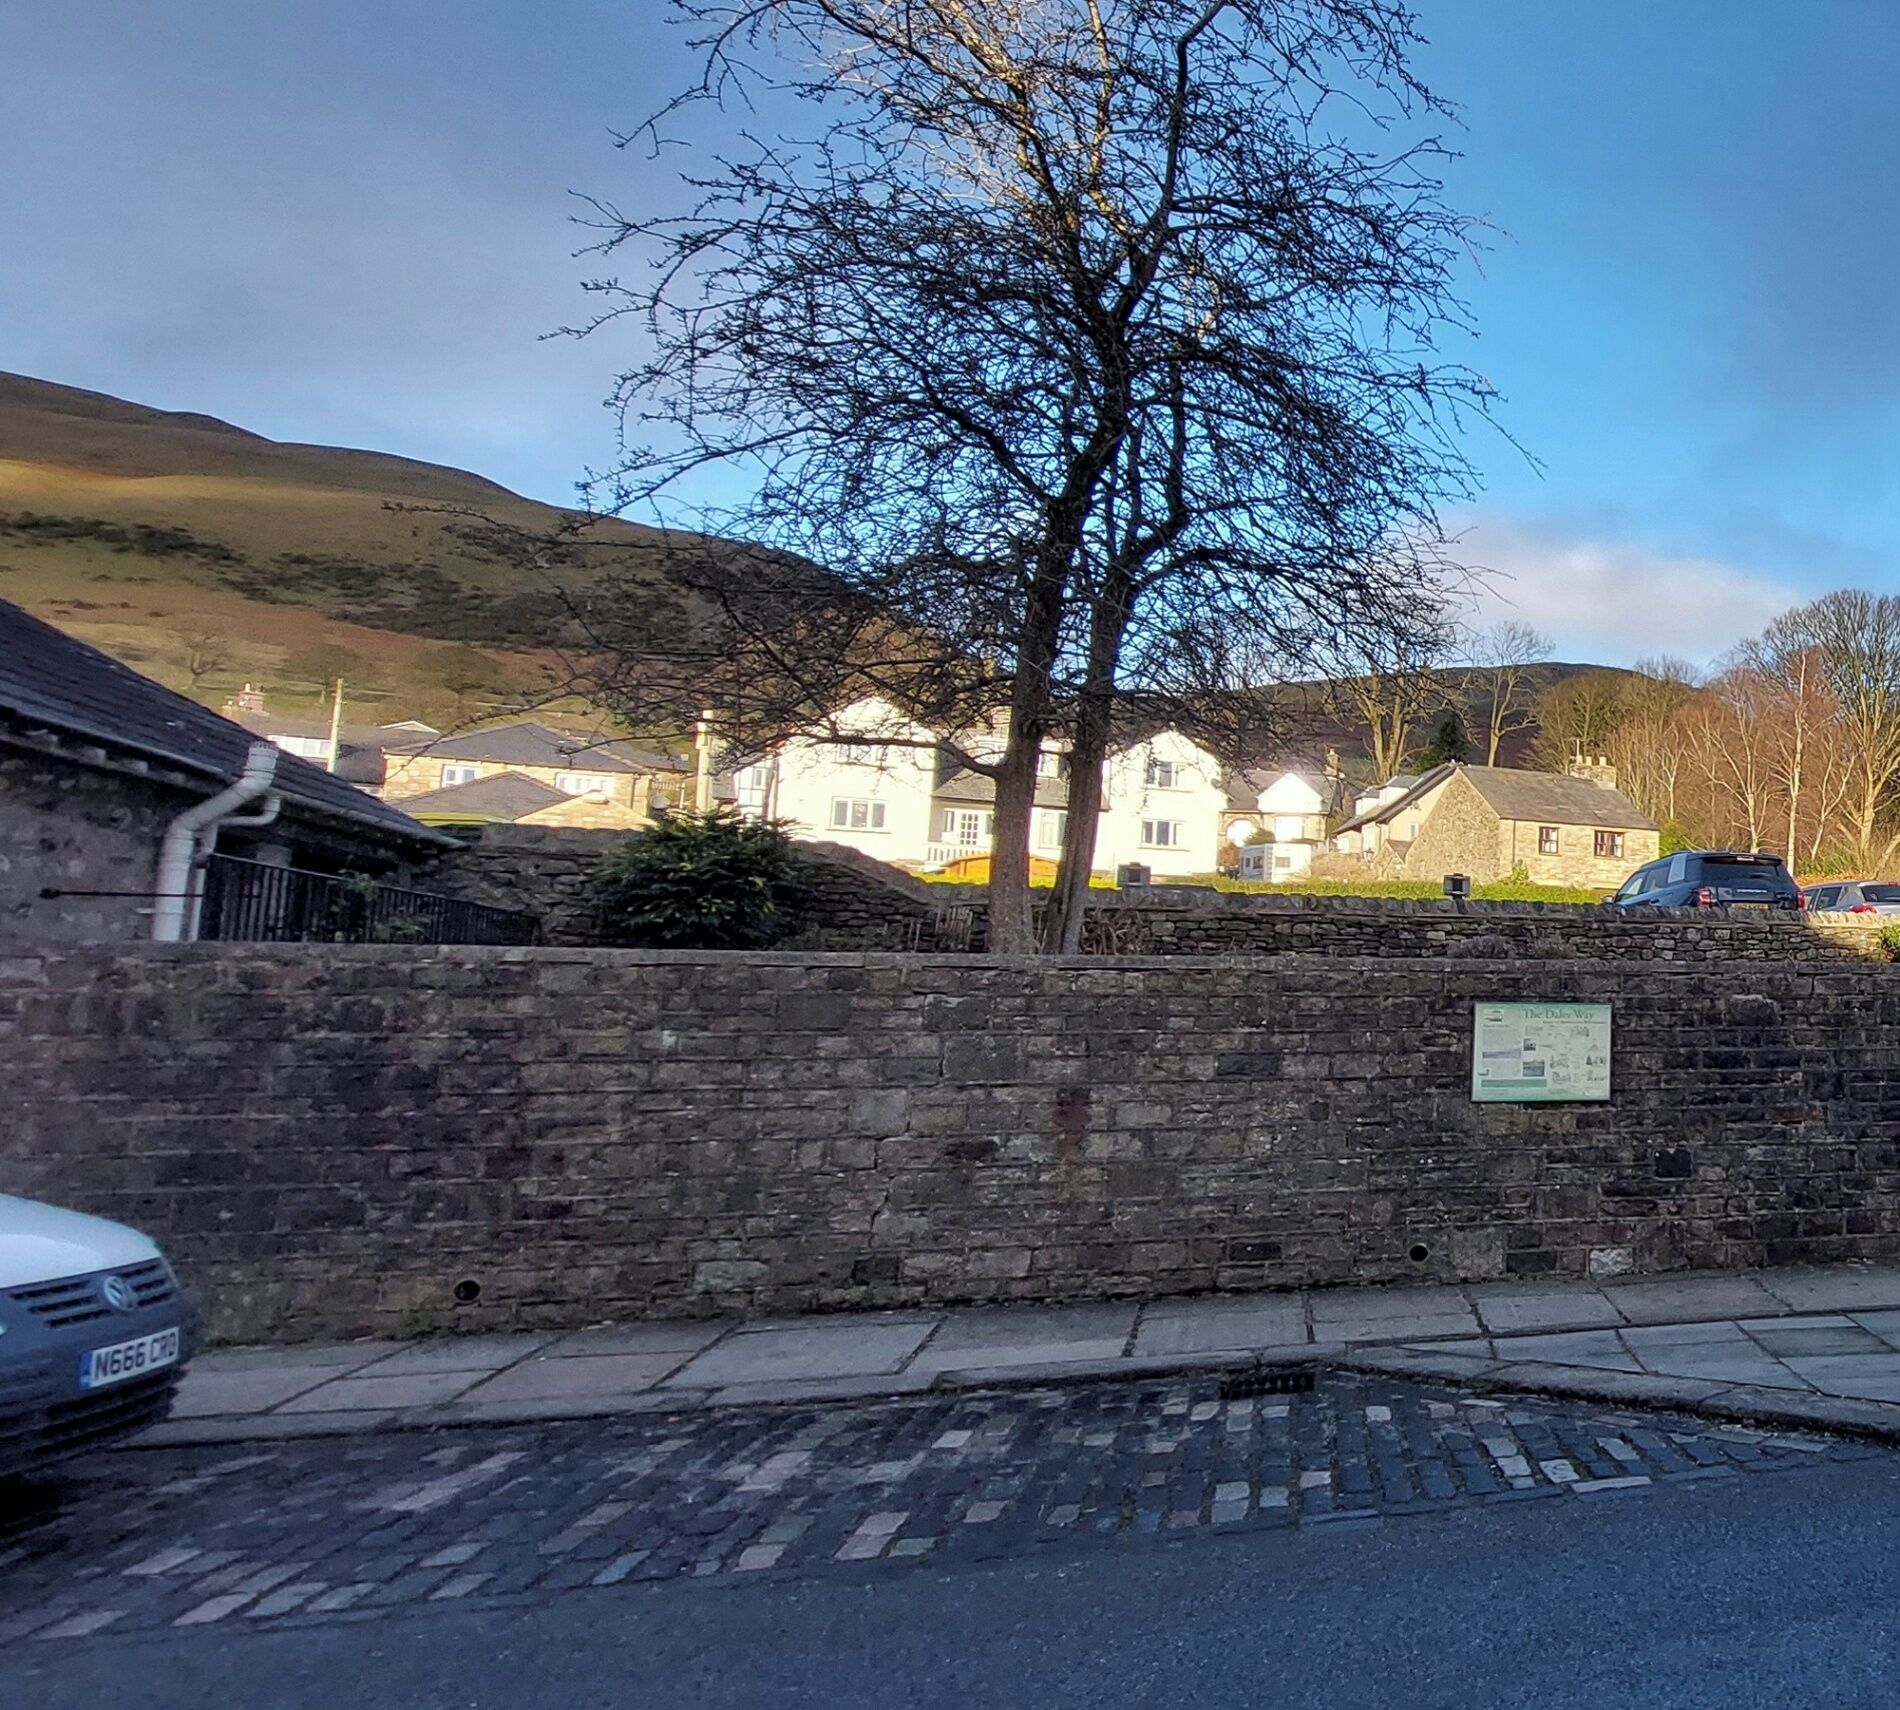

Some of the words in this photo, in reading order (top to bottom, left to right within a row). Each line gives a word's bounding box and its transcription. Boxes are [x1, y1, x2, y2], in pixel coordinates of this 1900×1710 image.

[1522, 1008, 1541, 1019] The
[1573, 1008, 1595, 1021] Way
[94, 1341, 146, 1381] N666
